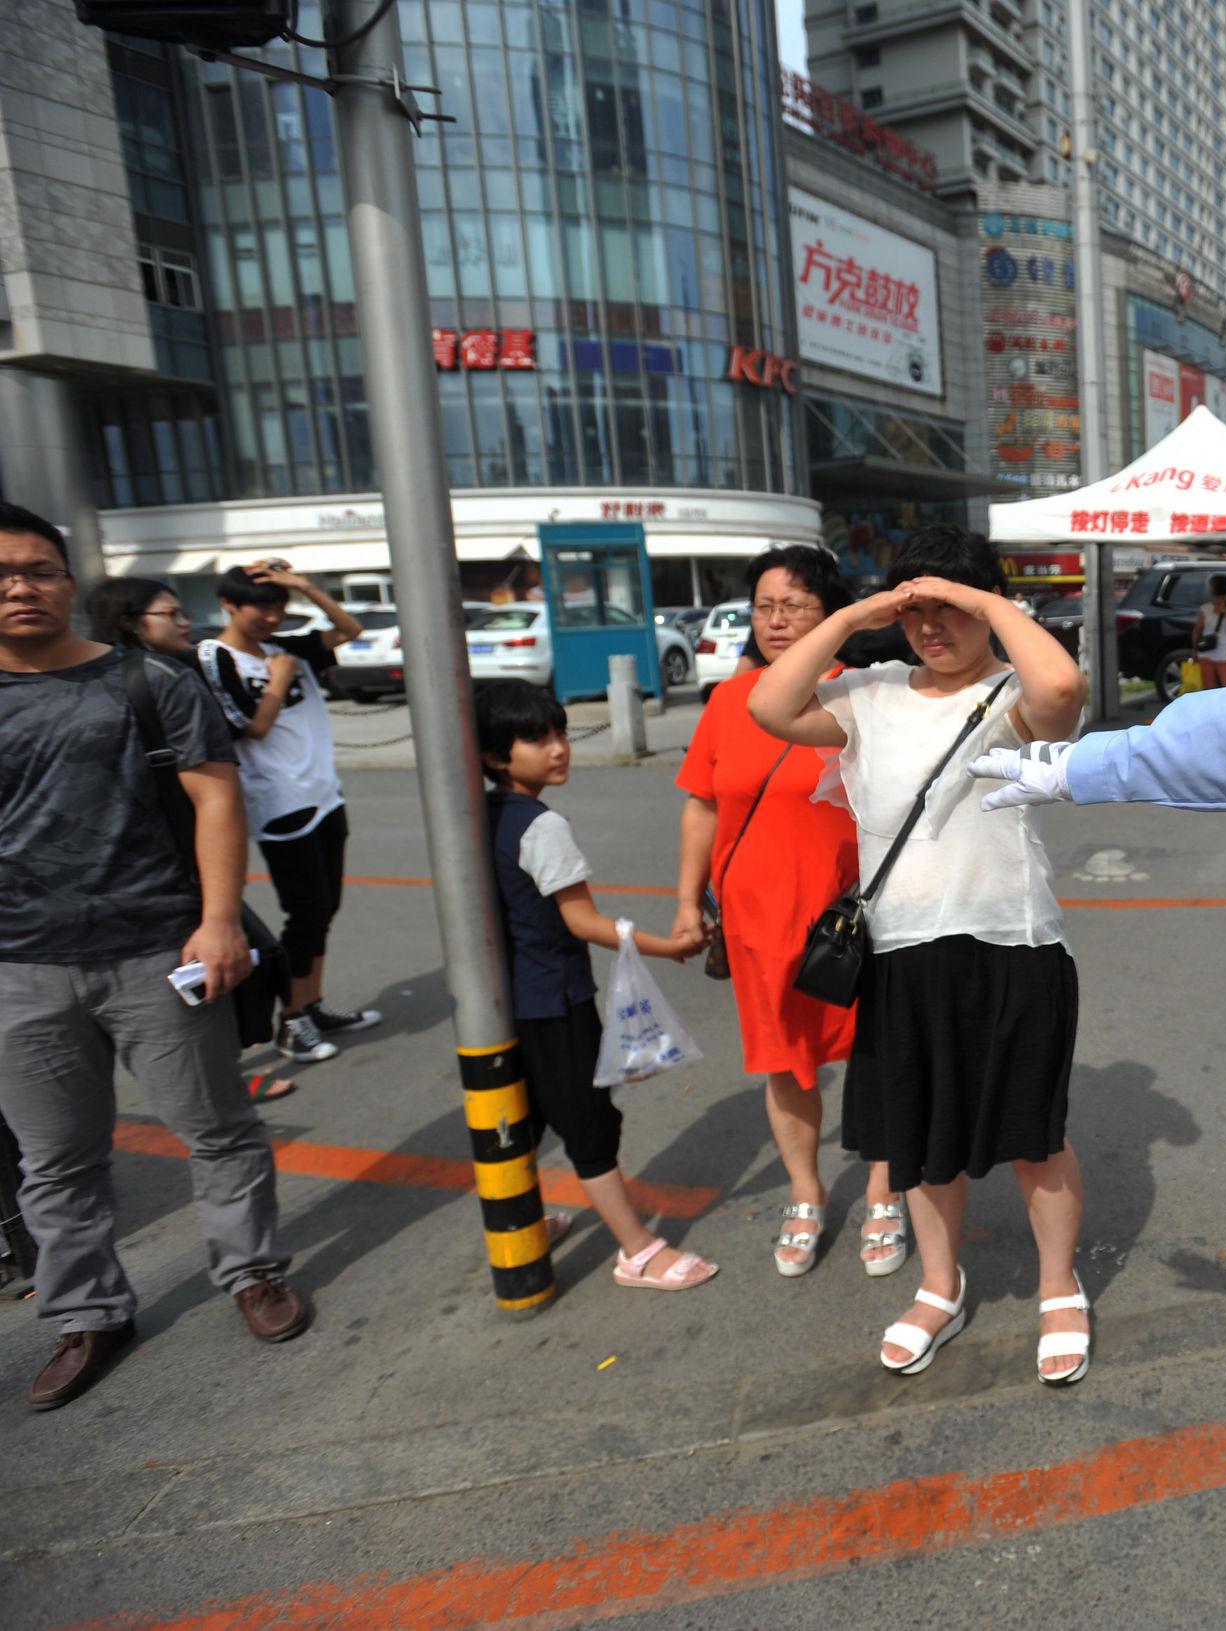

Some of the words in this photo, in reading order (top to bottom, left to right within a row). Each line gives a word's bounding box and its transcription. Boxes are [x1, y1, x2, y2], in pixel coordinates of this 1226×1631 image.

[728, 345, 799, 395] KFC
[1071, 511, 1149, 533] 按灯停走
